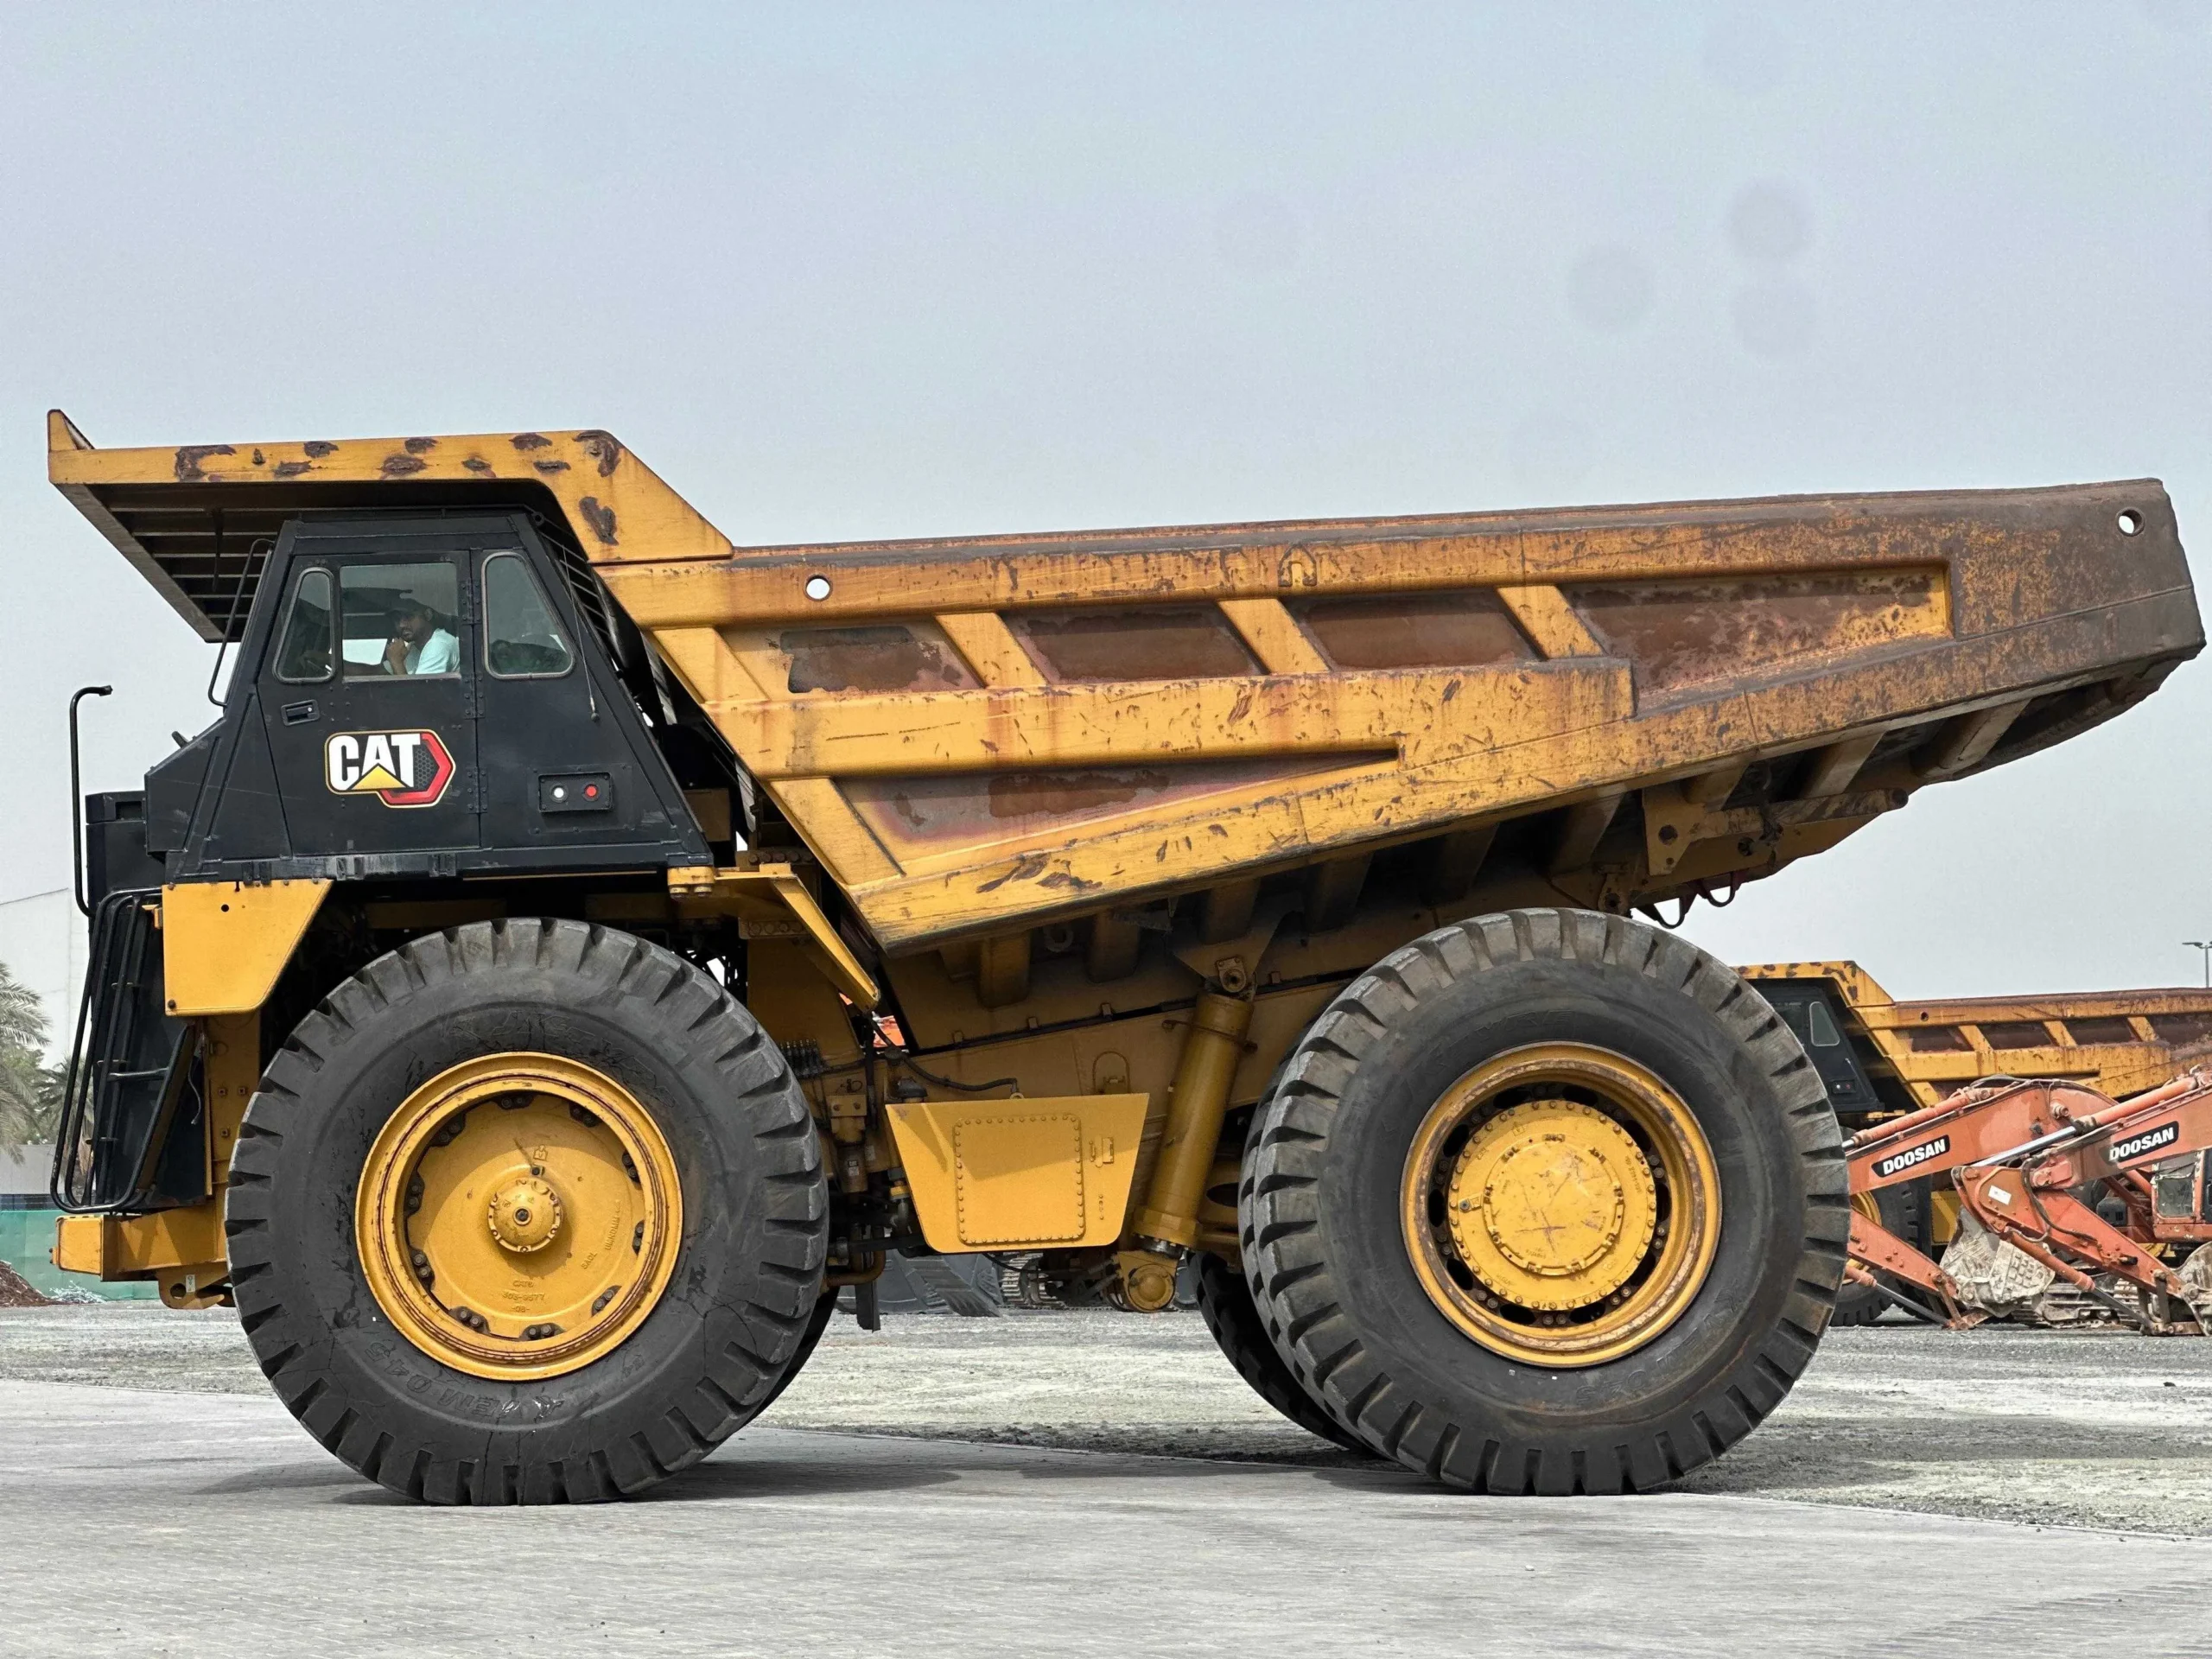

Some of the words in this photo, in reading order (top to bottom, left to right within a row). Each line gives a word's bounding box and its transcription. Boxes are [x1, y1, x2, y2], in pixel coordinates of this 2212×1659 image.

[329, 734, 421, 791] CAT
[1883, 1139, 1946, 1175] DOOSAN
[2109, 1127, 2174, 1160] DOOSAN
[365, 1339, 432, 1394] 045
